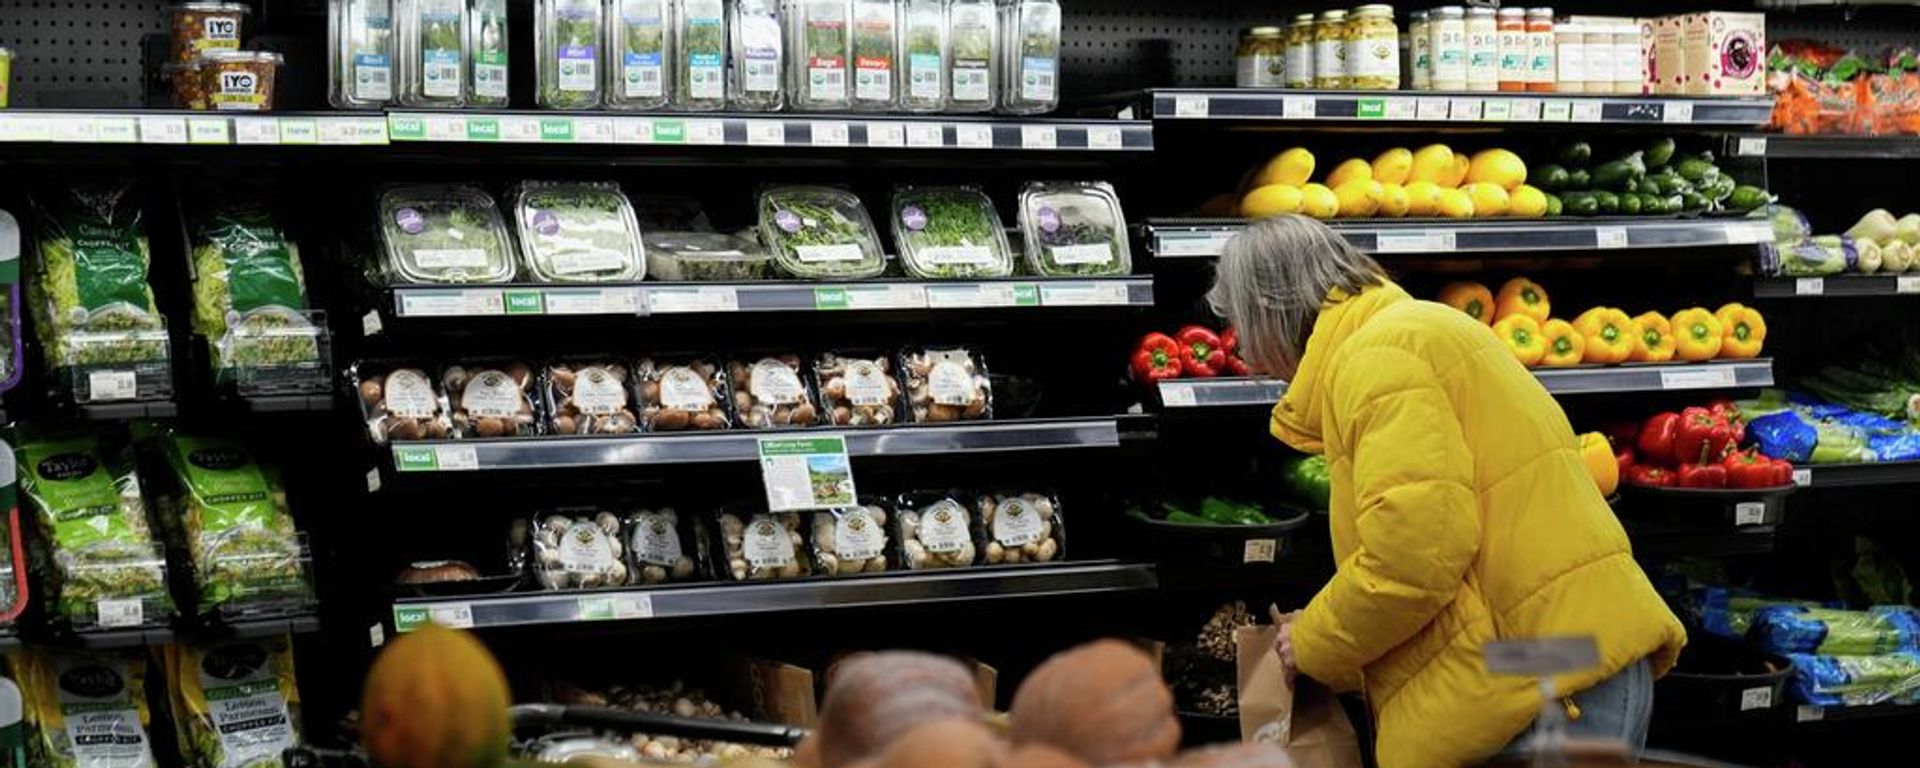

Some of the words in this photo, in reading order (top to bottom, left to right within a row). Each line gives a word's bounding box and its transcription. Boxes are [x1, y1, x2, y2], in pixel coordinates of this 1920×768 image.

[1361, 103, 1381, 112] local
[394, 119, 420, 131] local
[470, 122, 496, 133] local
[543, 122, 569, 134] local
[655, 124, 680, 135] local
[511, 294, 536, 306] local
[405, 450, 431, 462] local
[400, 612, 425, 623] local
